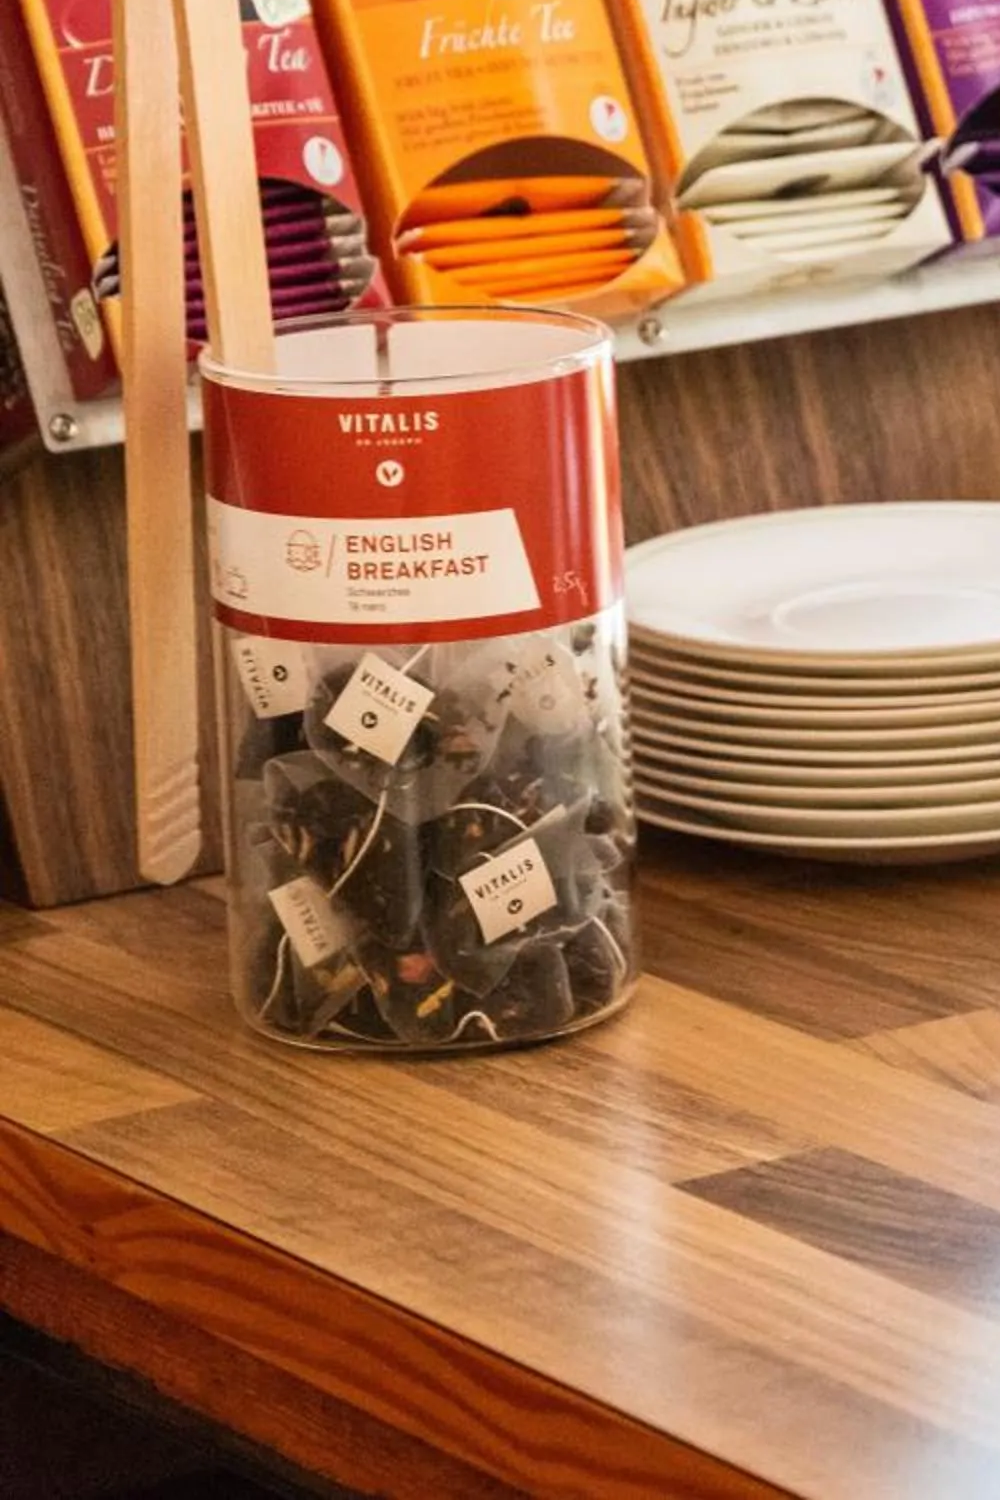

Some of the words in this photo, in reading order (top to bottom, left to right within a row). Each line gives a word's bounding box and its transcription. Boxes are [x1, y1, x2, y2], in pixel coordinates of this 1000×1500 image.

[257, 27, 311, 72] Tea
[338, 410, 440, 434] VITALIS
[345, 531, 453, 554] ENGLISH
[347, 555, 489, 581] BREAKFAST
[360, 669, 417, 714] VITALIS
[474, 858, 535, 900] VITALIS
